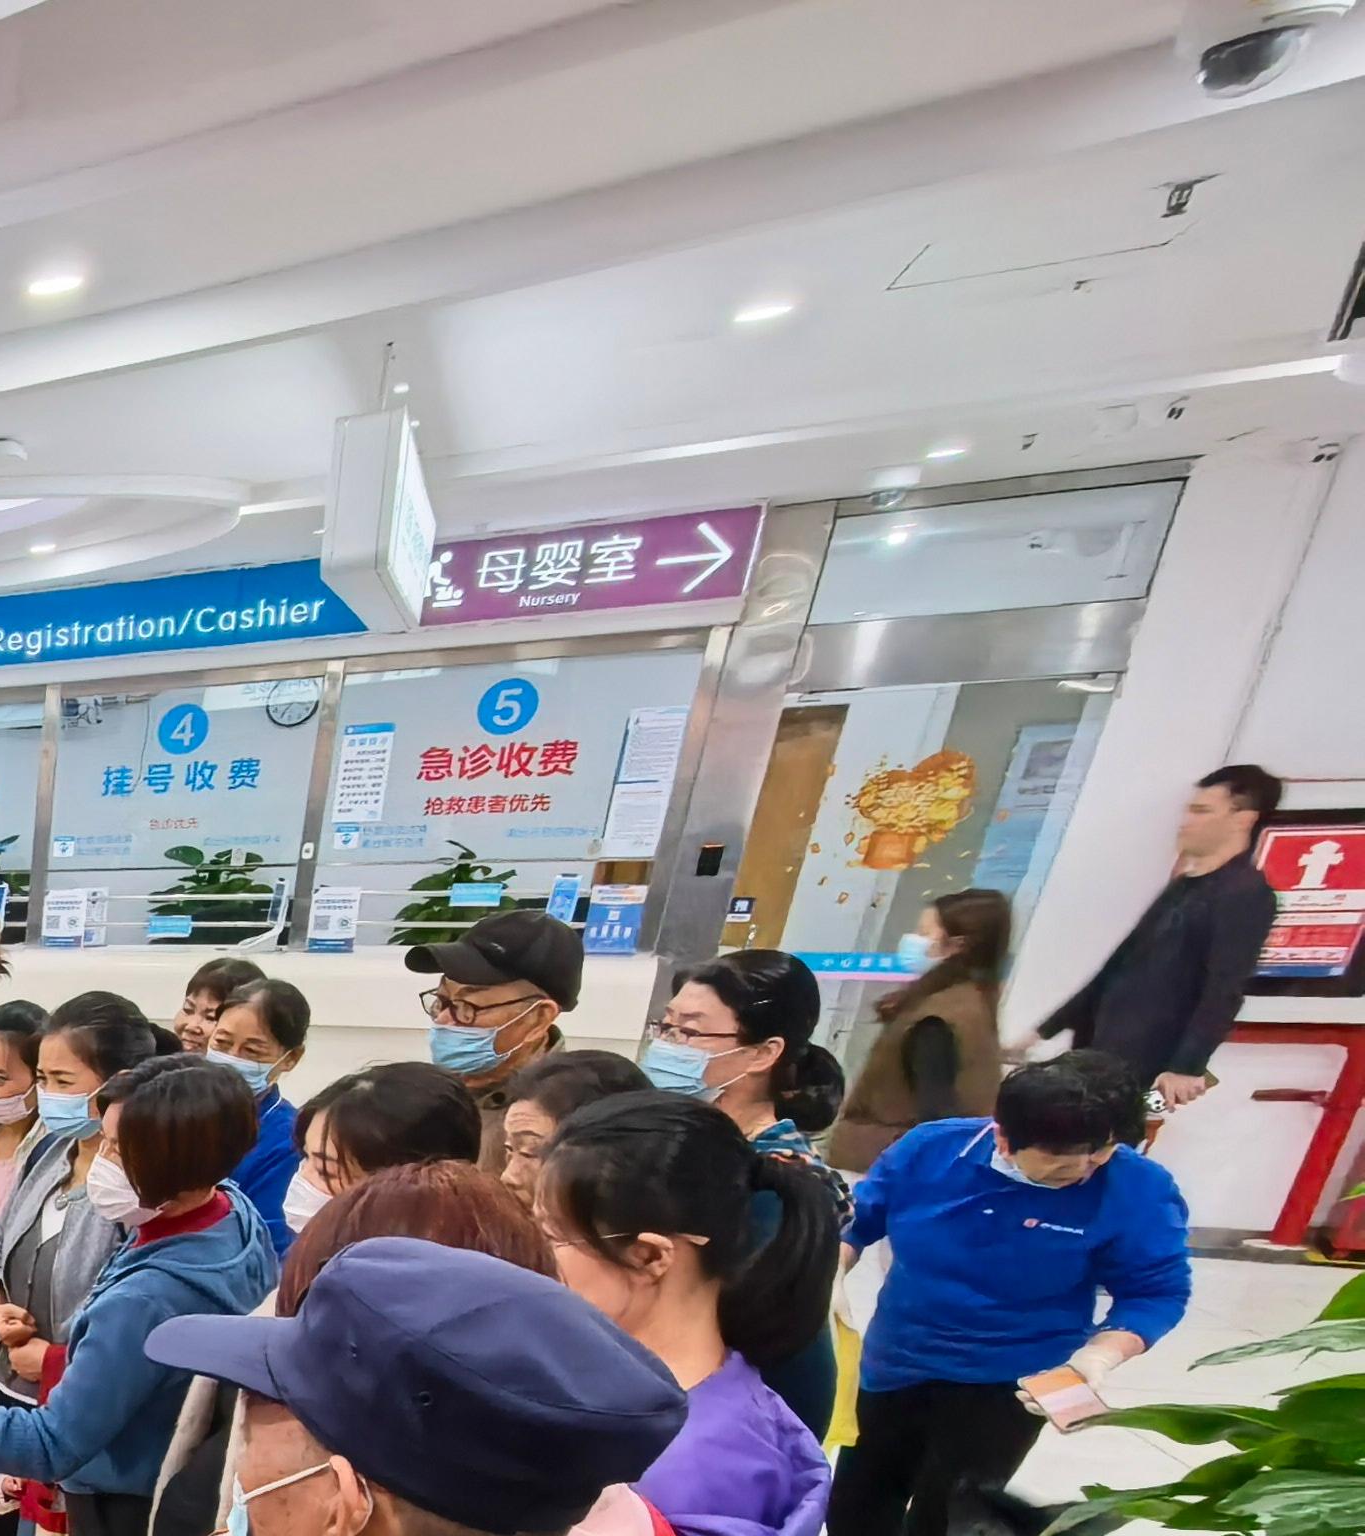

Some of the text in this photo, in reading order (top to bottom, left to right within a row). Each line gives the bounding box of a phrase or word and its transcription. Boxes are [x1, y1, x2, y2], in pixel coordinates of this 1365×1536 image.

[476, 534, 645, 596] 母婴室
[519, 590, 581, 609] Nursery
[492, 688, 524, 727] 5
[172, 714, 196, 747] 4
[102, 758, 263, 799] 挂号收费
[416, 739, 579, 783] 急诊收费
[423, 793, 552, 817] 抢救患者优先
